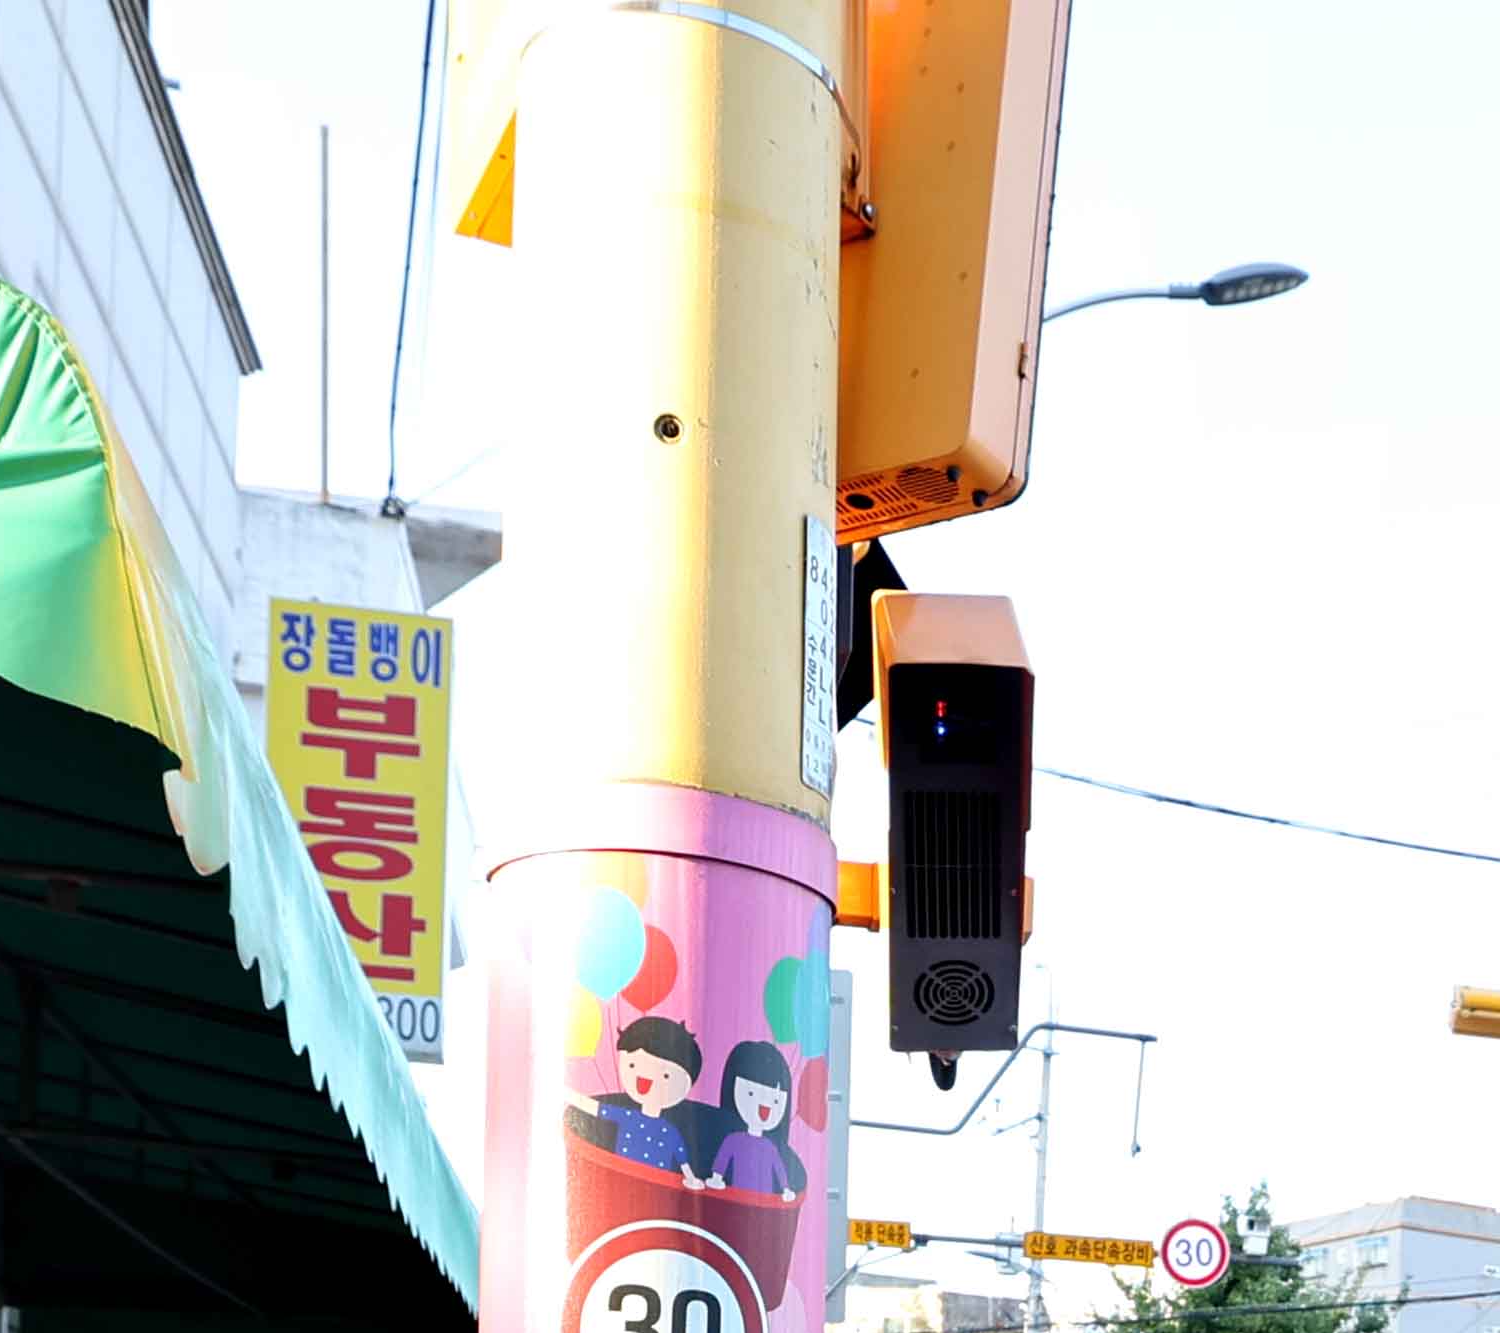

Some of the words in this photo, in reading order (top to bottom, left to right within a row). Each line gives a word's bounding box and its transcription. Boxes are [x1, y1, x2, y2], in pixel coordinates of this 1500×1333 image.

[280, 612, 444, 689] 장돌뱅이
[299, 686, 428, 983] 부동산
[1029, 1235, 1057, 1257] 신호
[1064, 1238, 1152, 1265] 과속단속장비
[1175, 1237, 1214, 1267] 30
